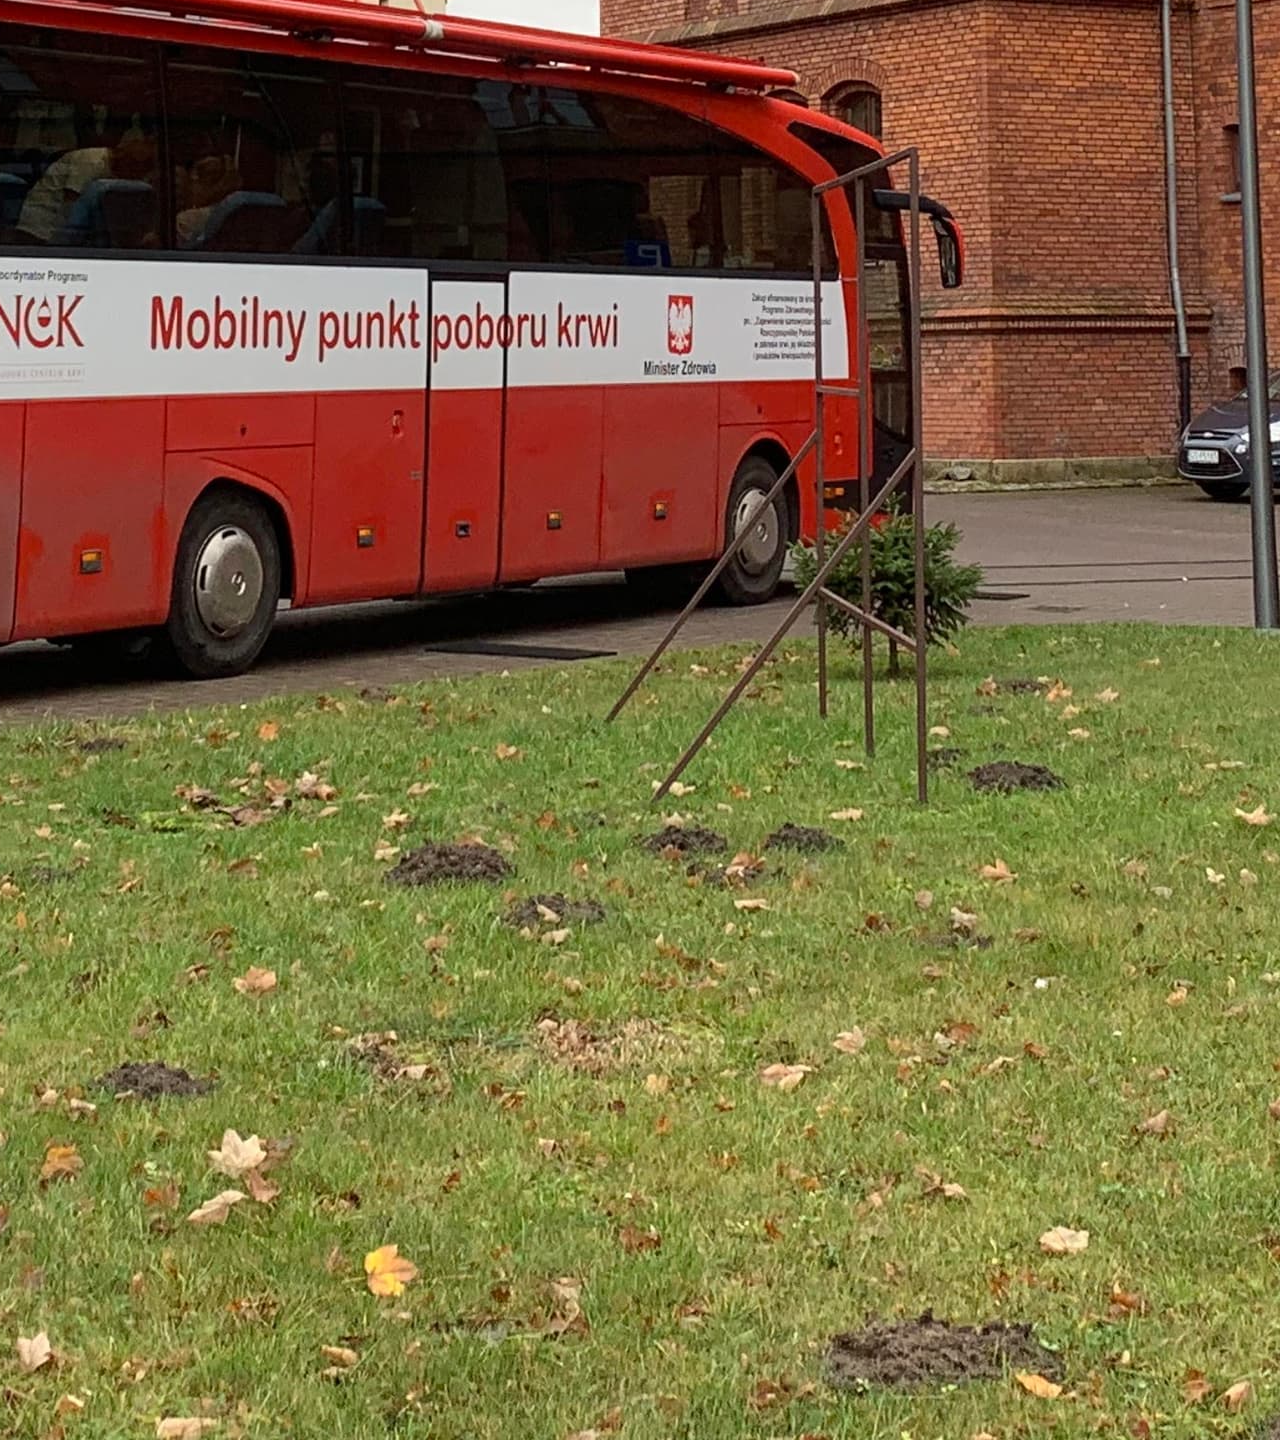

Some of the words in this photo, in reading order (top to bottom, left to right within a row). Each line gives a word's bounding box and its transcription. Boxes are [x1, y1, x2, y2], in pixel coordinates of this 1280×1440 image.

[47, 269, 89, 285] Programu
[150, 295, 307, 362] Mobilny
[319, 298, 421, 363] punkt
[433, 301, 547, 363] poboru
[557, 302, 619, 349] krwi
[643, 360, 680, 376] Minister
[681, 360, 717, 376] Zdrowia
